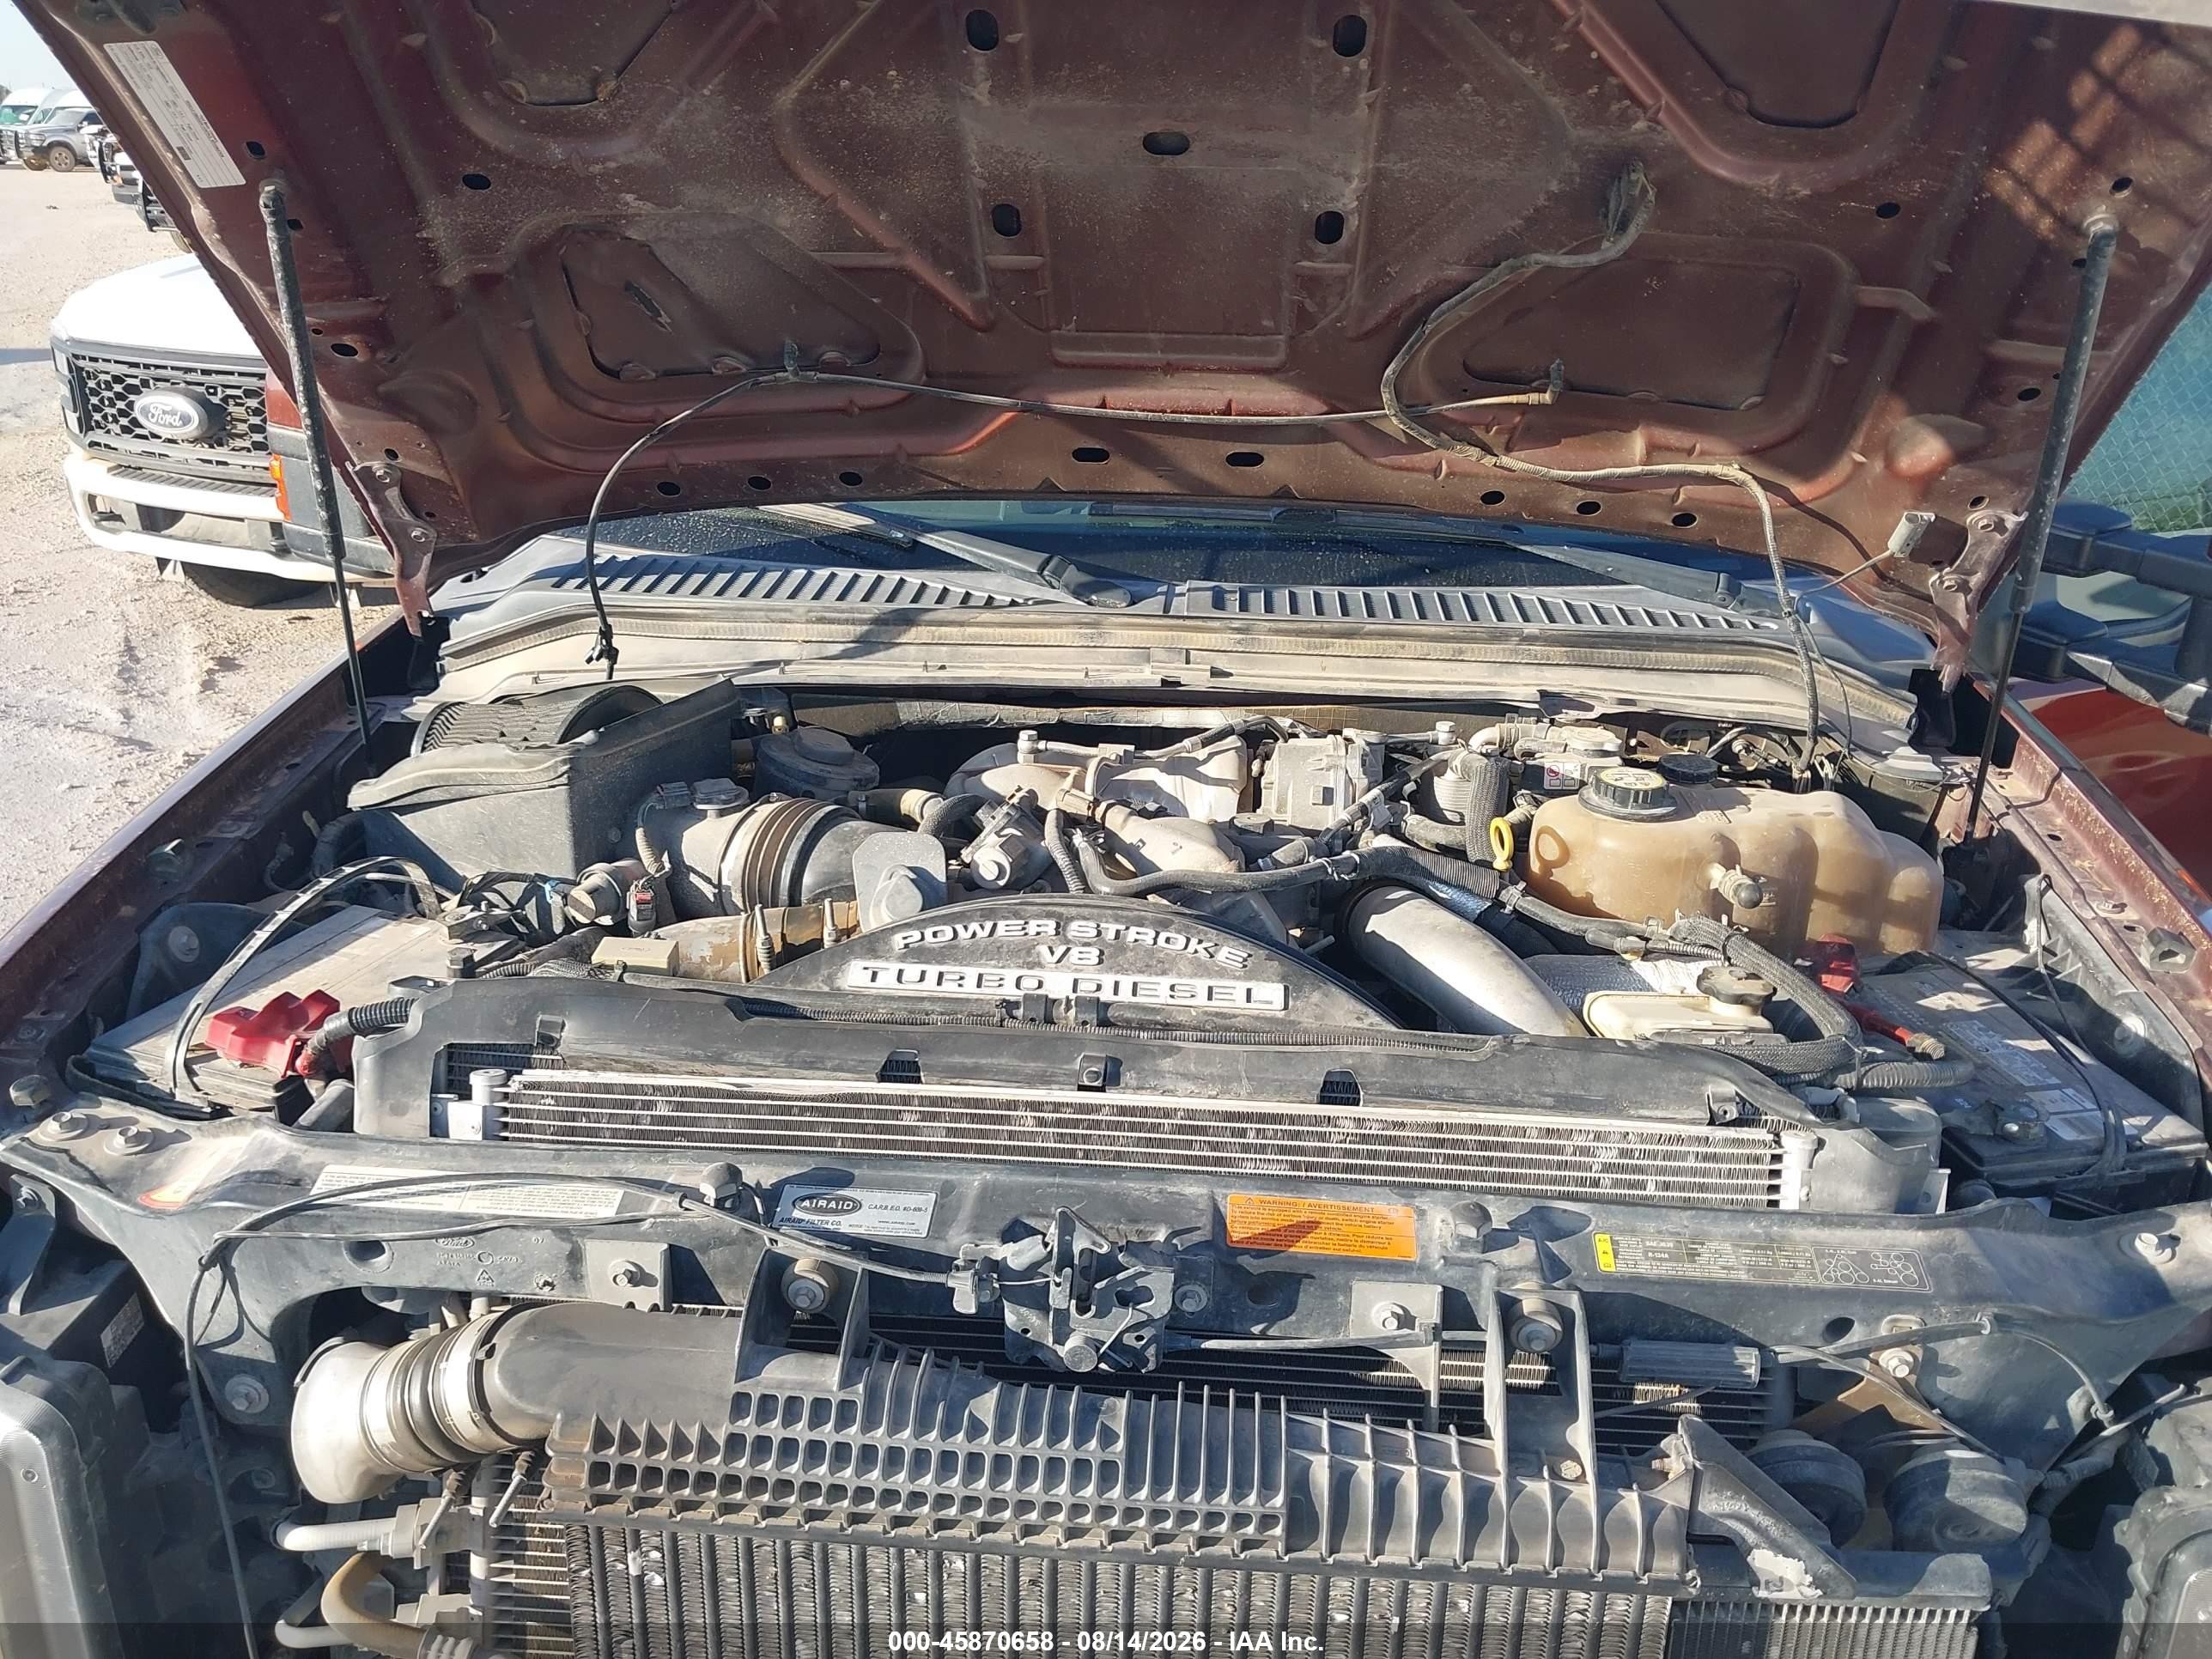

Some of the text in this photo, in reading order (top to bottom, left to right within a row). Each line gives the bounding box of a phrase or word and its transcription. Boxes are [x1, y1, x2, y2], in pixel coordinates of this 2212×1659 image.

[149, 403, 183, 427] Ford
[895, 919, 1252, 969] POWER STROKE
[1036, 944, 1103, 967] V8
[862, 965, 1274, 1006] TURBO DIESEL
[1307, 1202, 1374, 1212] AVERTISSEMENT
